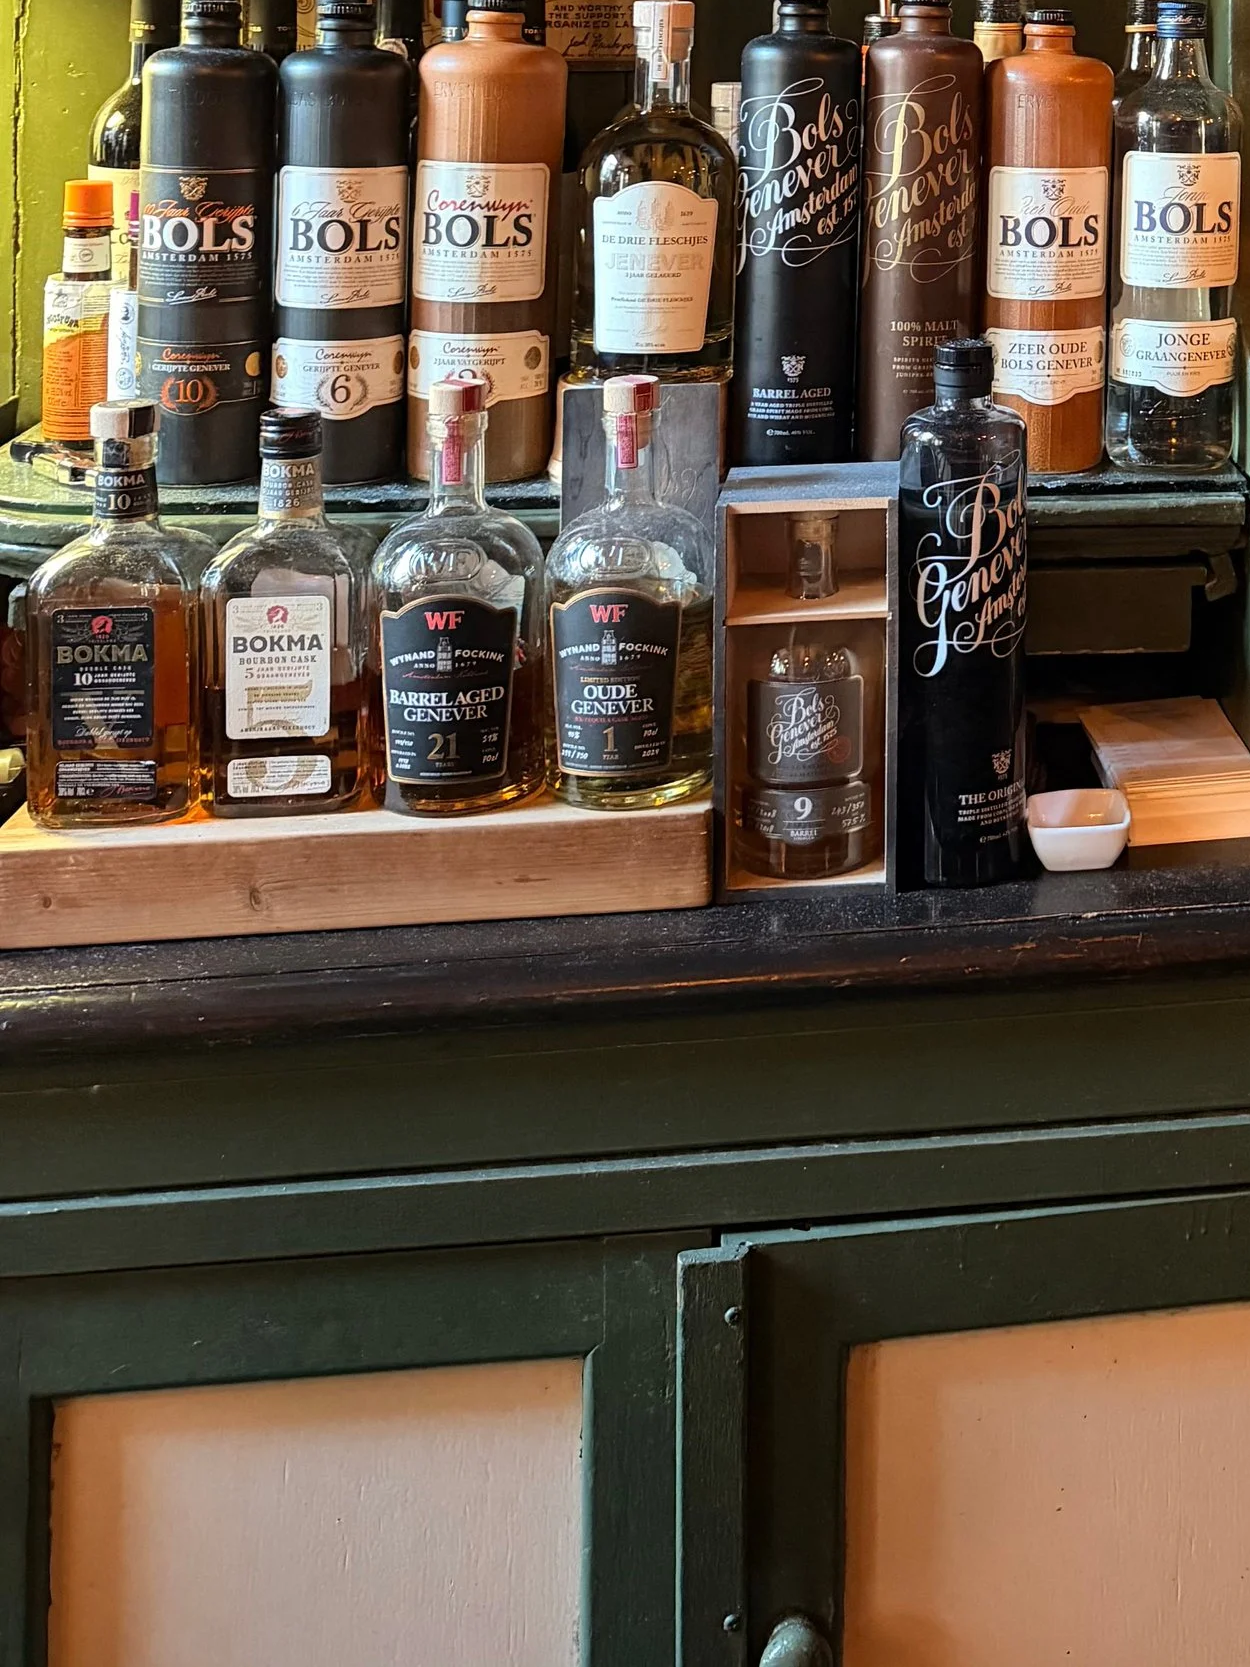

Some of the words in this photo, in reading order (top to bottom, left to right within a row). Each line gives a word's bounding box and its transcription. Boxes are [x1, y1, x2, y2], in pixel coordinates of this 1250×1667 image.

[574, 12, 626, 20] SUPPORT
[748, 91, 844, 181] Bols
[875, 91, 974, 181] Bols
[305, 200, 344, 220] Jaar
[427, 190, 531, 221] Corenwyn
[1133, 200, 1233, 235] BOLS
[142, 215, 256, 253] BOLS
[289, 218, 401, 253] BOLS
[422, 212, 533, 248] BOLS
[999, 214, 1100, 249] BOLS
[601, 234, 616, 244] DE
[618, 235, 646, 245] DRIE
[648, 235, 709, 247] FLESCHJES
[1133, 235, 1209, 244] AMSTERDAM
[1213, 234, 1232, 243] 1575
[142, 252, 220, 262] AMSTERDAM
[226, 252, 253, 261] 1575
[289, 254, 374, 263] AMSTERDAM
[422, 249, 500, 258] AMSTERDAM
[506, 248, 533, 258] 1575
[999, 250, 1074, 259] AMSTERDAM
[1080, 249, 1100, 258] 1575
[604, 252, 704, 272] JENEVER
[890, 321, 921, 332] 100%
[924, 320, 959, 332] MALT
[1008, 342, 1045, 355] ZEER
[1049, 341, 1088, 355] OUDE
[1156, 332, 1211, 348] JONGE
[442, 341, 500, 357] Corenwyn
[1136, 349, 1228, 362] GRAANGENEVER
[151, 363, 188, 372] GERIJPTE
[188, 363, 231, 372] GENEVER
[302, 363, 342, 373] GERIJPTE
[343, 362, 381, 372] GENEVER
[1001, 359, 1034, 371] BOLS
[1036, 357, 1093, 371] GENEVER
[175, 378, 204, 403] 10
[329, 374, 352, 403] 6
[752, 387, 799, 399] BARREL
[800, 387, 831, 399] AGED
[263, 462, 315, 479] BOKMA
[98, 473, 146, 487] BOKMA
[107, 493, 131, 511] 10
[273, 497, 300, 509] 1826
[56, 615, 65, 624] 3
[423, 610, 465, 631] WF
[589, 603, 629, 624] WF
[232, 634, 324, 654] BOKMA
[558, 643, 600, 659] WYNAND
[618, 642, 669, 657] FOCKINK
[56, 644, 149, 665] BOKMA
[238, 656, 288, 666] BOURBON
[290, 654, 318, 664] CASK
[389, 650, 436, 667] WYNAND
[454, 649, 506, 663] FOCKINK
[73, 672, 93, 686] 10
[244, 667, 255, 680] 5
[389, 689, 454, 707] BARREL
[454, 686, 505, 706] AGED
[582, 684, 638, 701] OUDE
[403, 705, 488, 723] GENEVER
[570, 698, 654, 716] GENEVER
[783, 692, 825, 728] Bols
[426, 732, 461, 761] 21
[602, 725, 618, 752] 1
[958, 792, 987, 806] THE
[793, 796, 814, 821] 9
